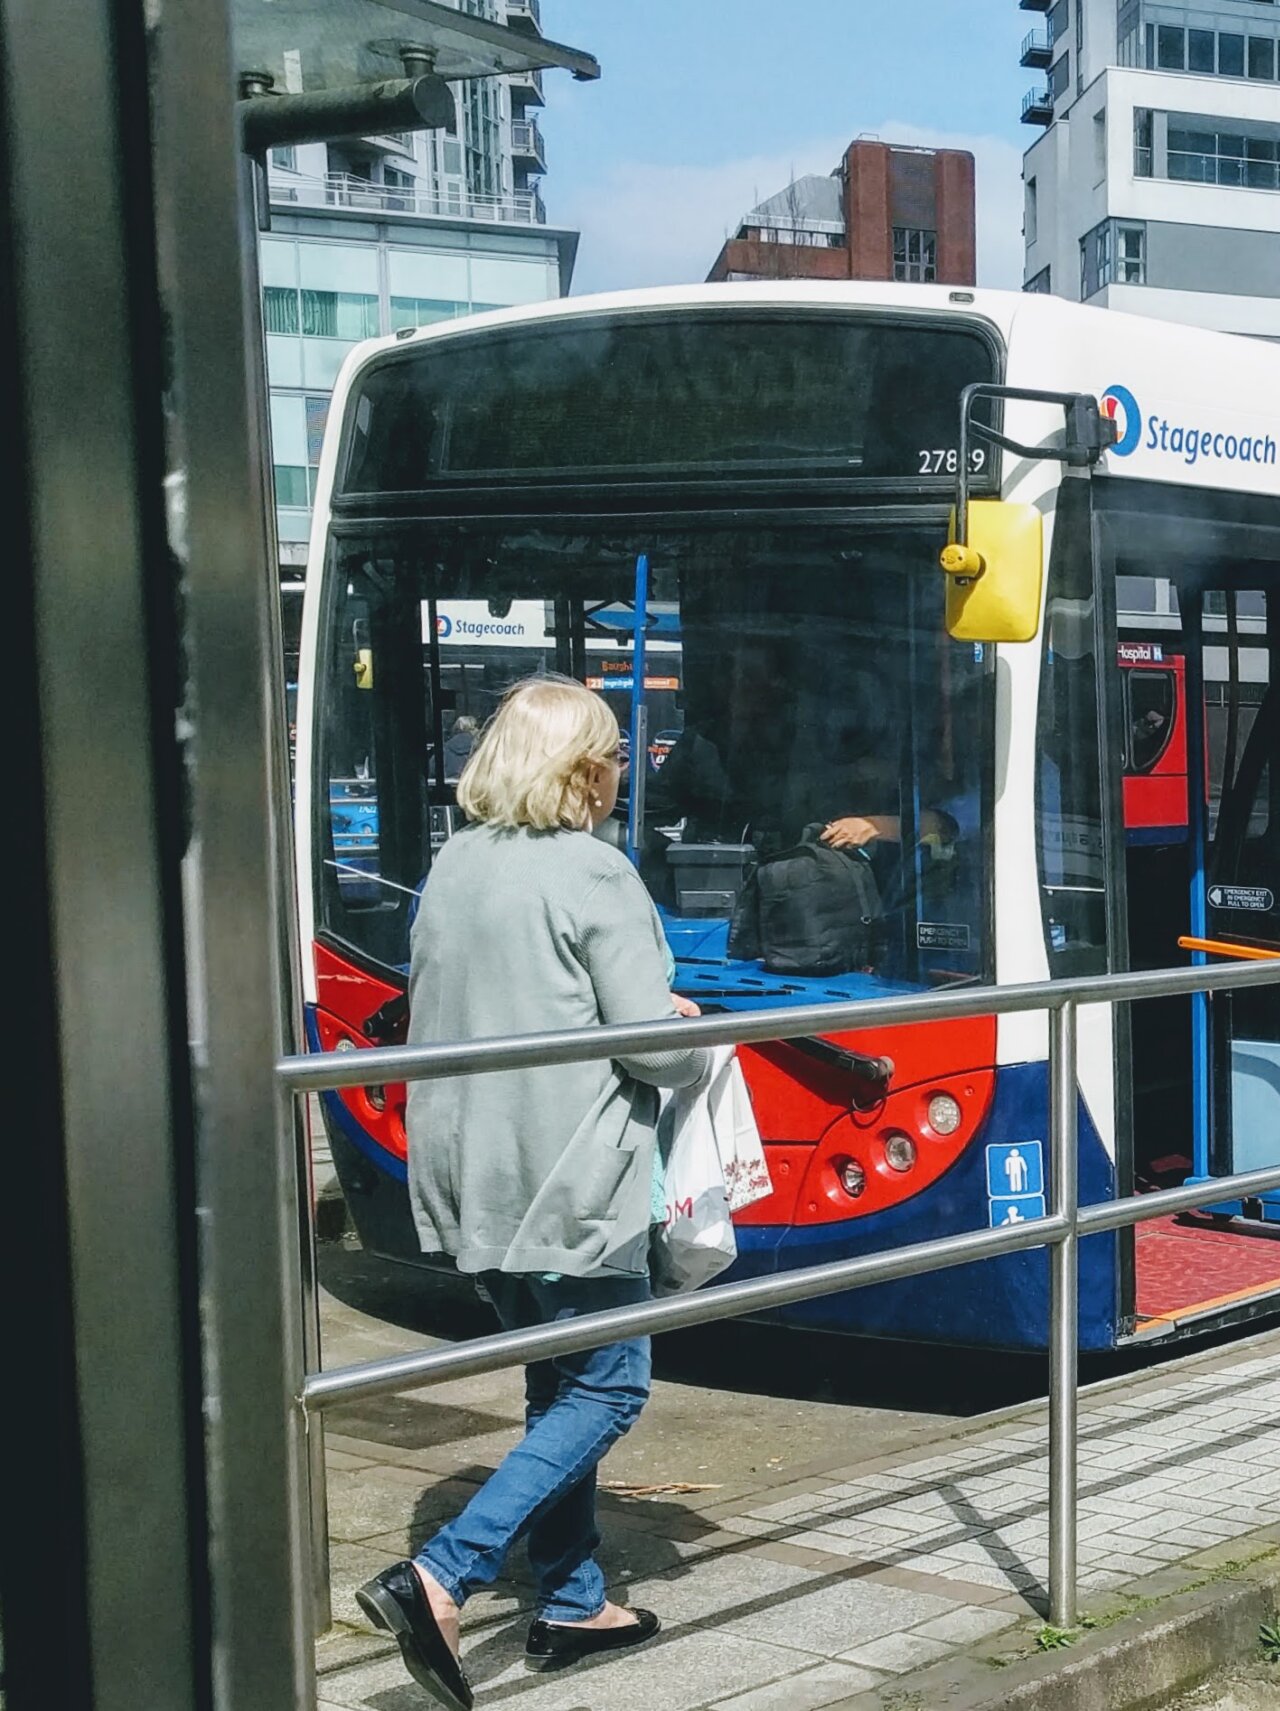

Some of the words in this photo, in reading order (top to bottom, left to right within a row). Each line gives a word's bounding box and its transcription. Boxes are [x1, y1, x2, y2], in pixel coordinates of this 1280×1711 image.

[1147, 416, 1277, 465] Stagecoach
[919, 449, 985, 474] 2789
[455, 619, 525, 638] Stagecoach
